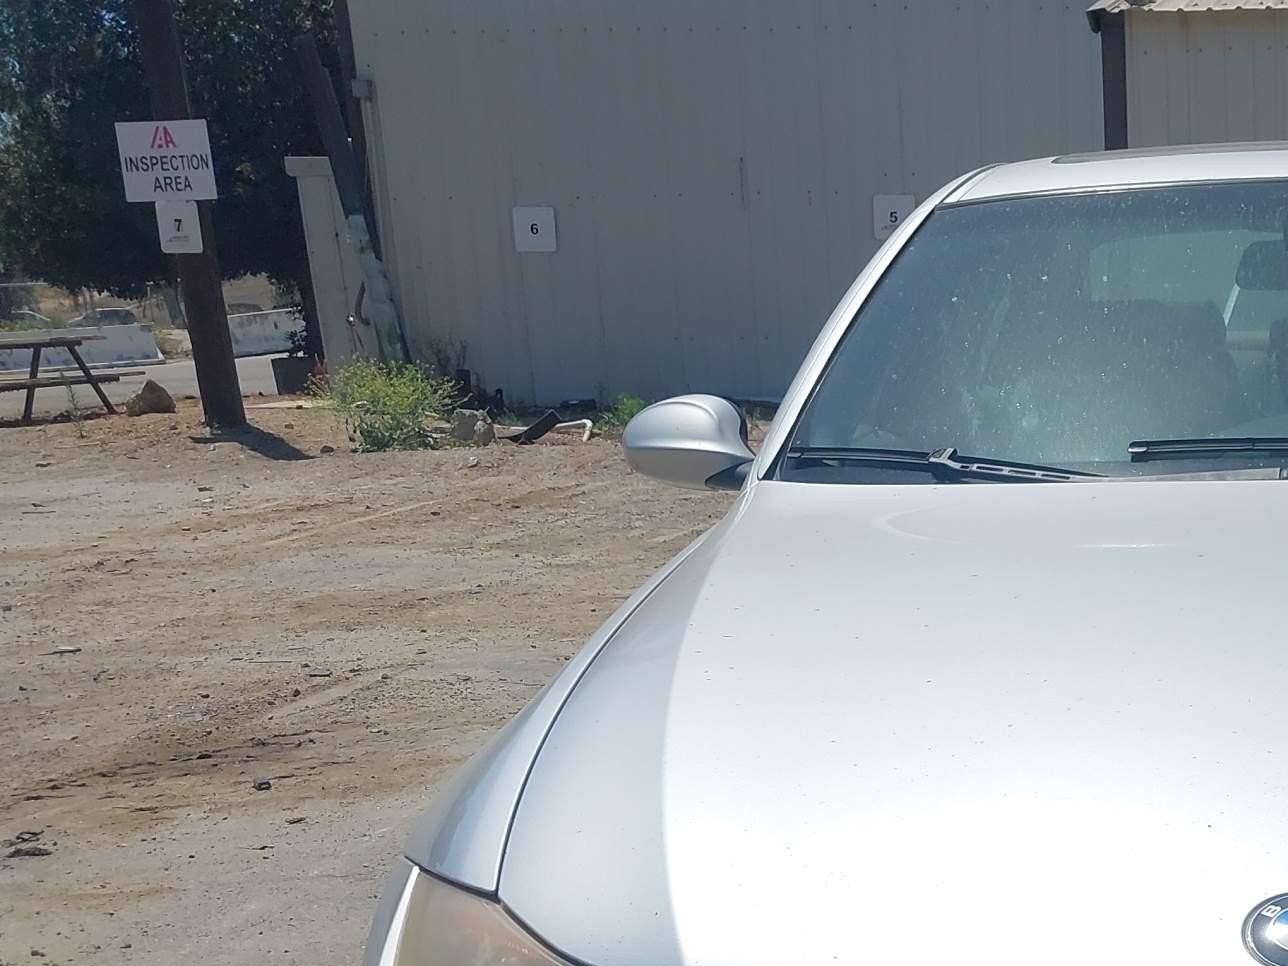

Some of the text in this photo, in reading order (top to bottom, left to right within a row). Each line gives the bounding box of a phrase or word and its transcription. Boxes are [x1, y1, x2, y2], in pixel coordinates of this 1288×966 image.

[124, 154, 209, 172] INSPECTION
[153, 176, 193, 192] AREA
[889, 211, 898, 223] 5
[173, 218, 182, 232] 7
[530, 223, 539, 235] 6
